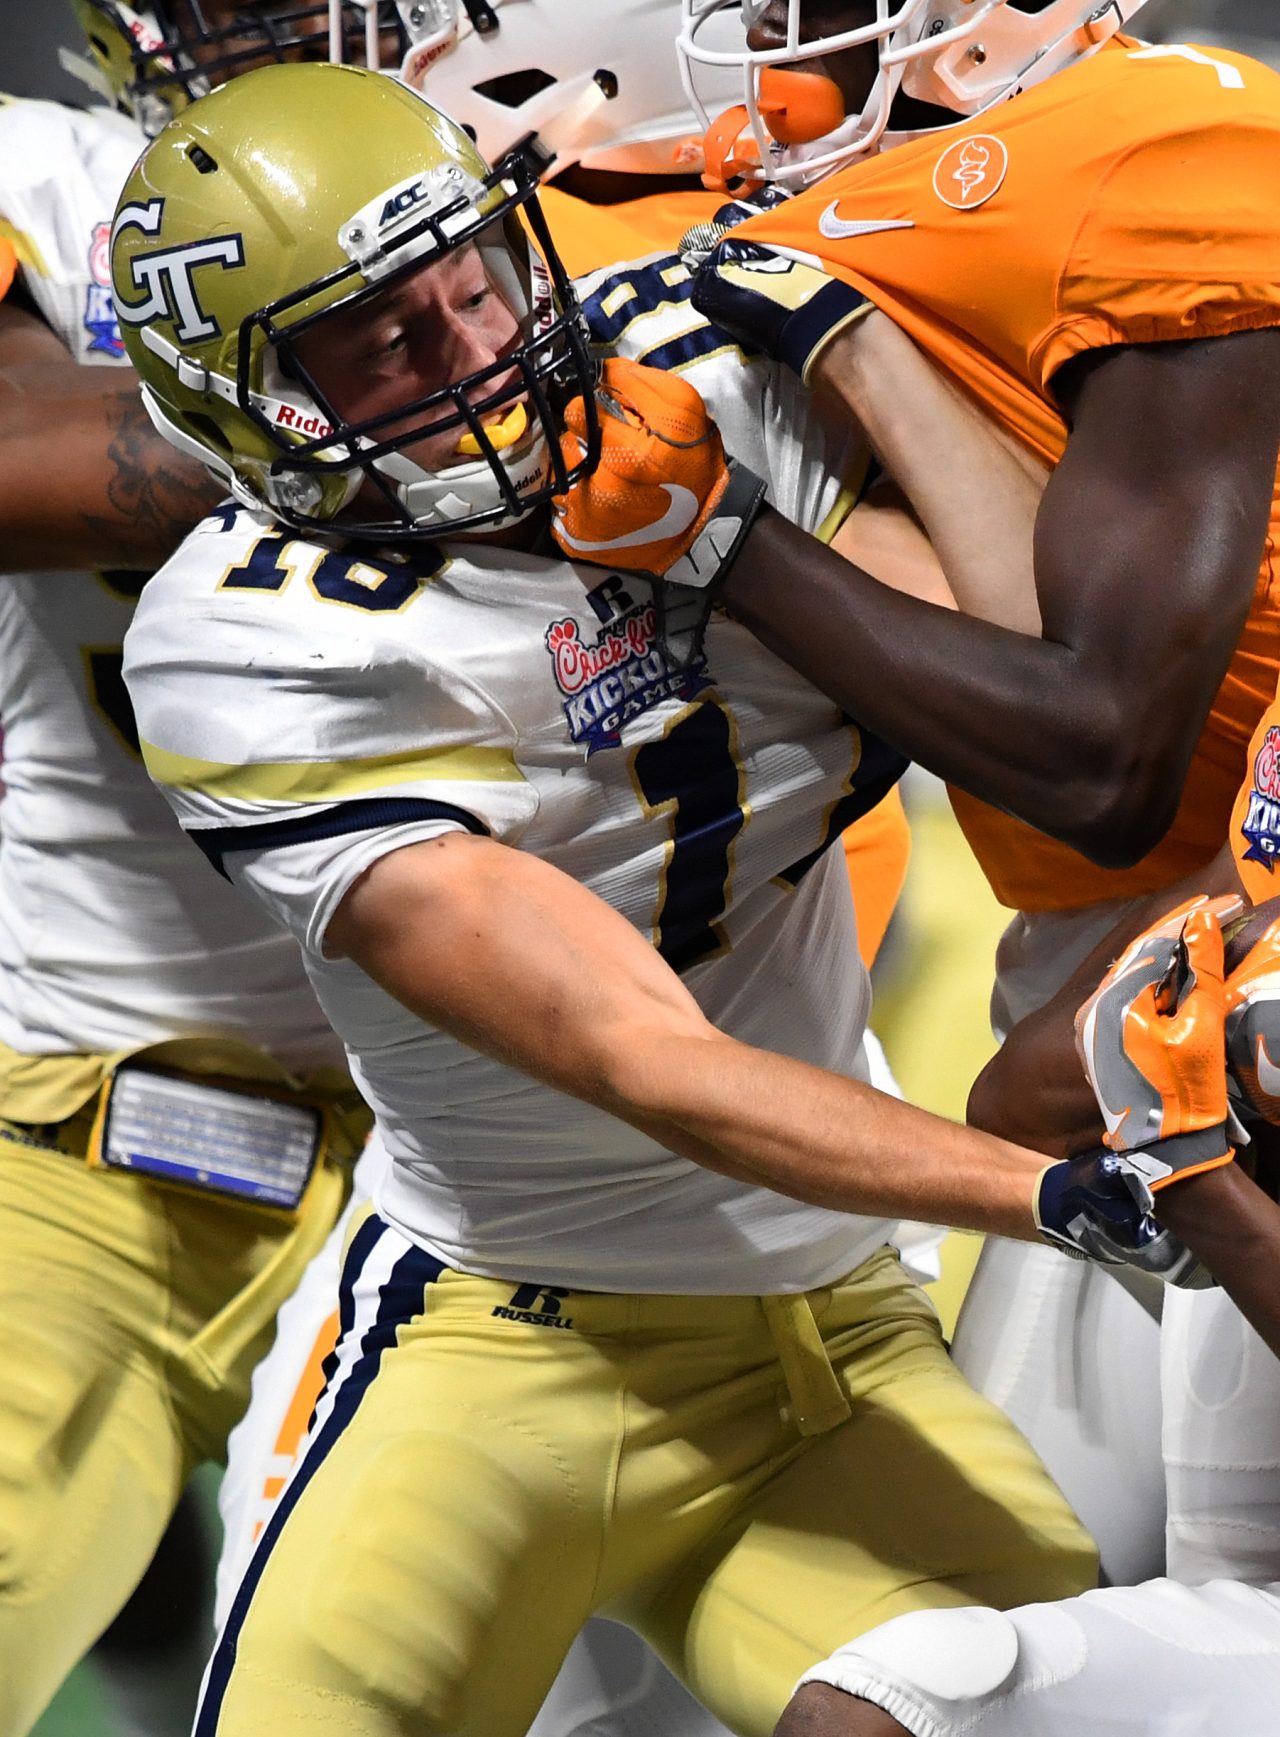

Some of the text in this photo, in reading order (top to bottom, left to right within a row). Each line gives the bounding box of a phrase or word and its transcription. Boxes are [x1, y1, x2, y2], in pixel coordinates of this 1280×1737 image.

[378, 181, 428, 226] ACC
[276, 403, 335, 438] Ridd
[567, 649, 670, 736] KICKO
[602, 674, 687, 732] GAME
[491, 1306, 575, 1330] RUSSELL
